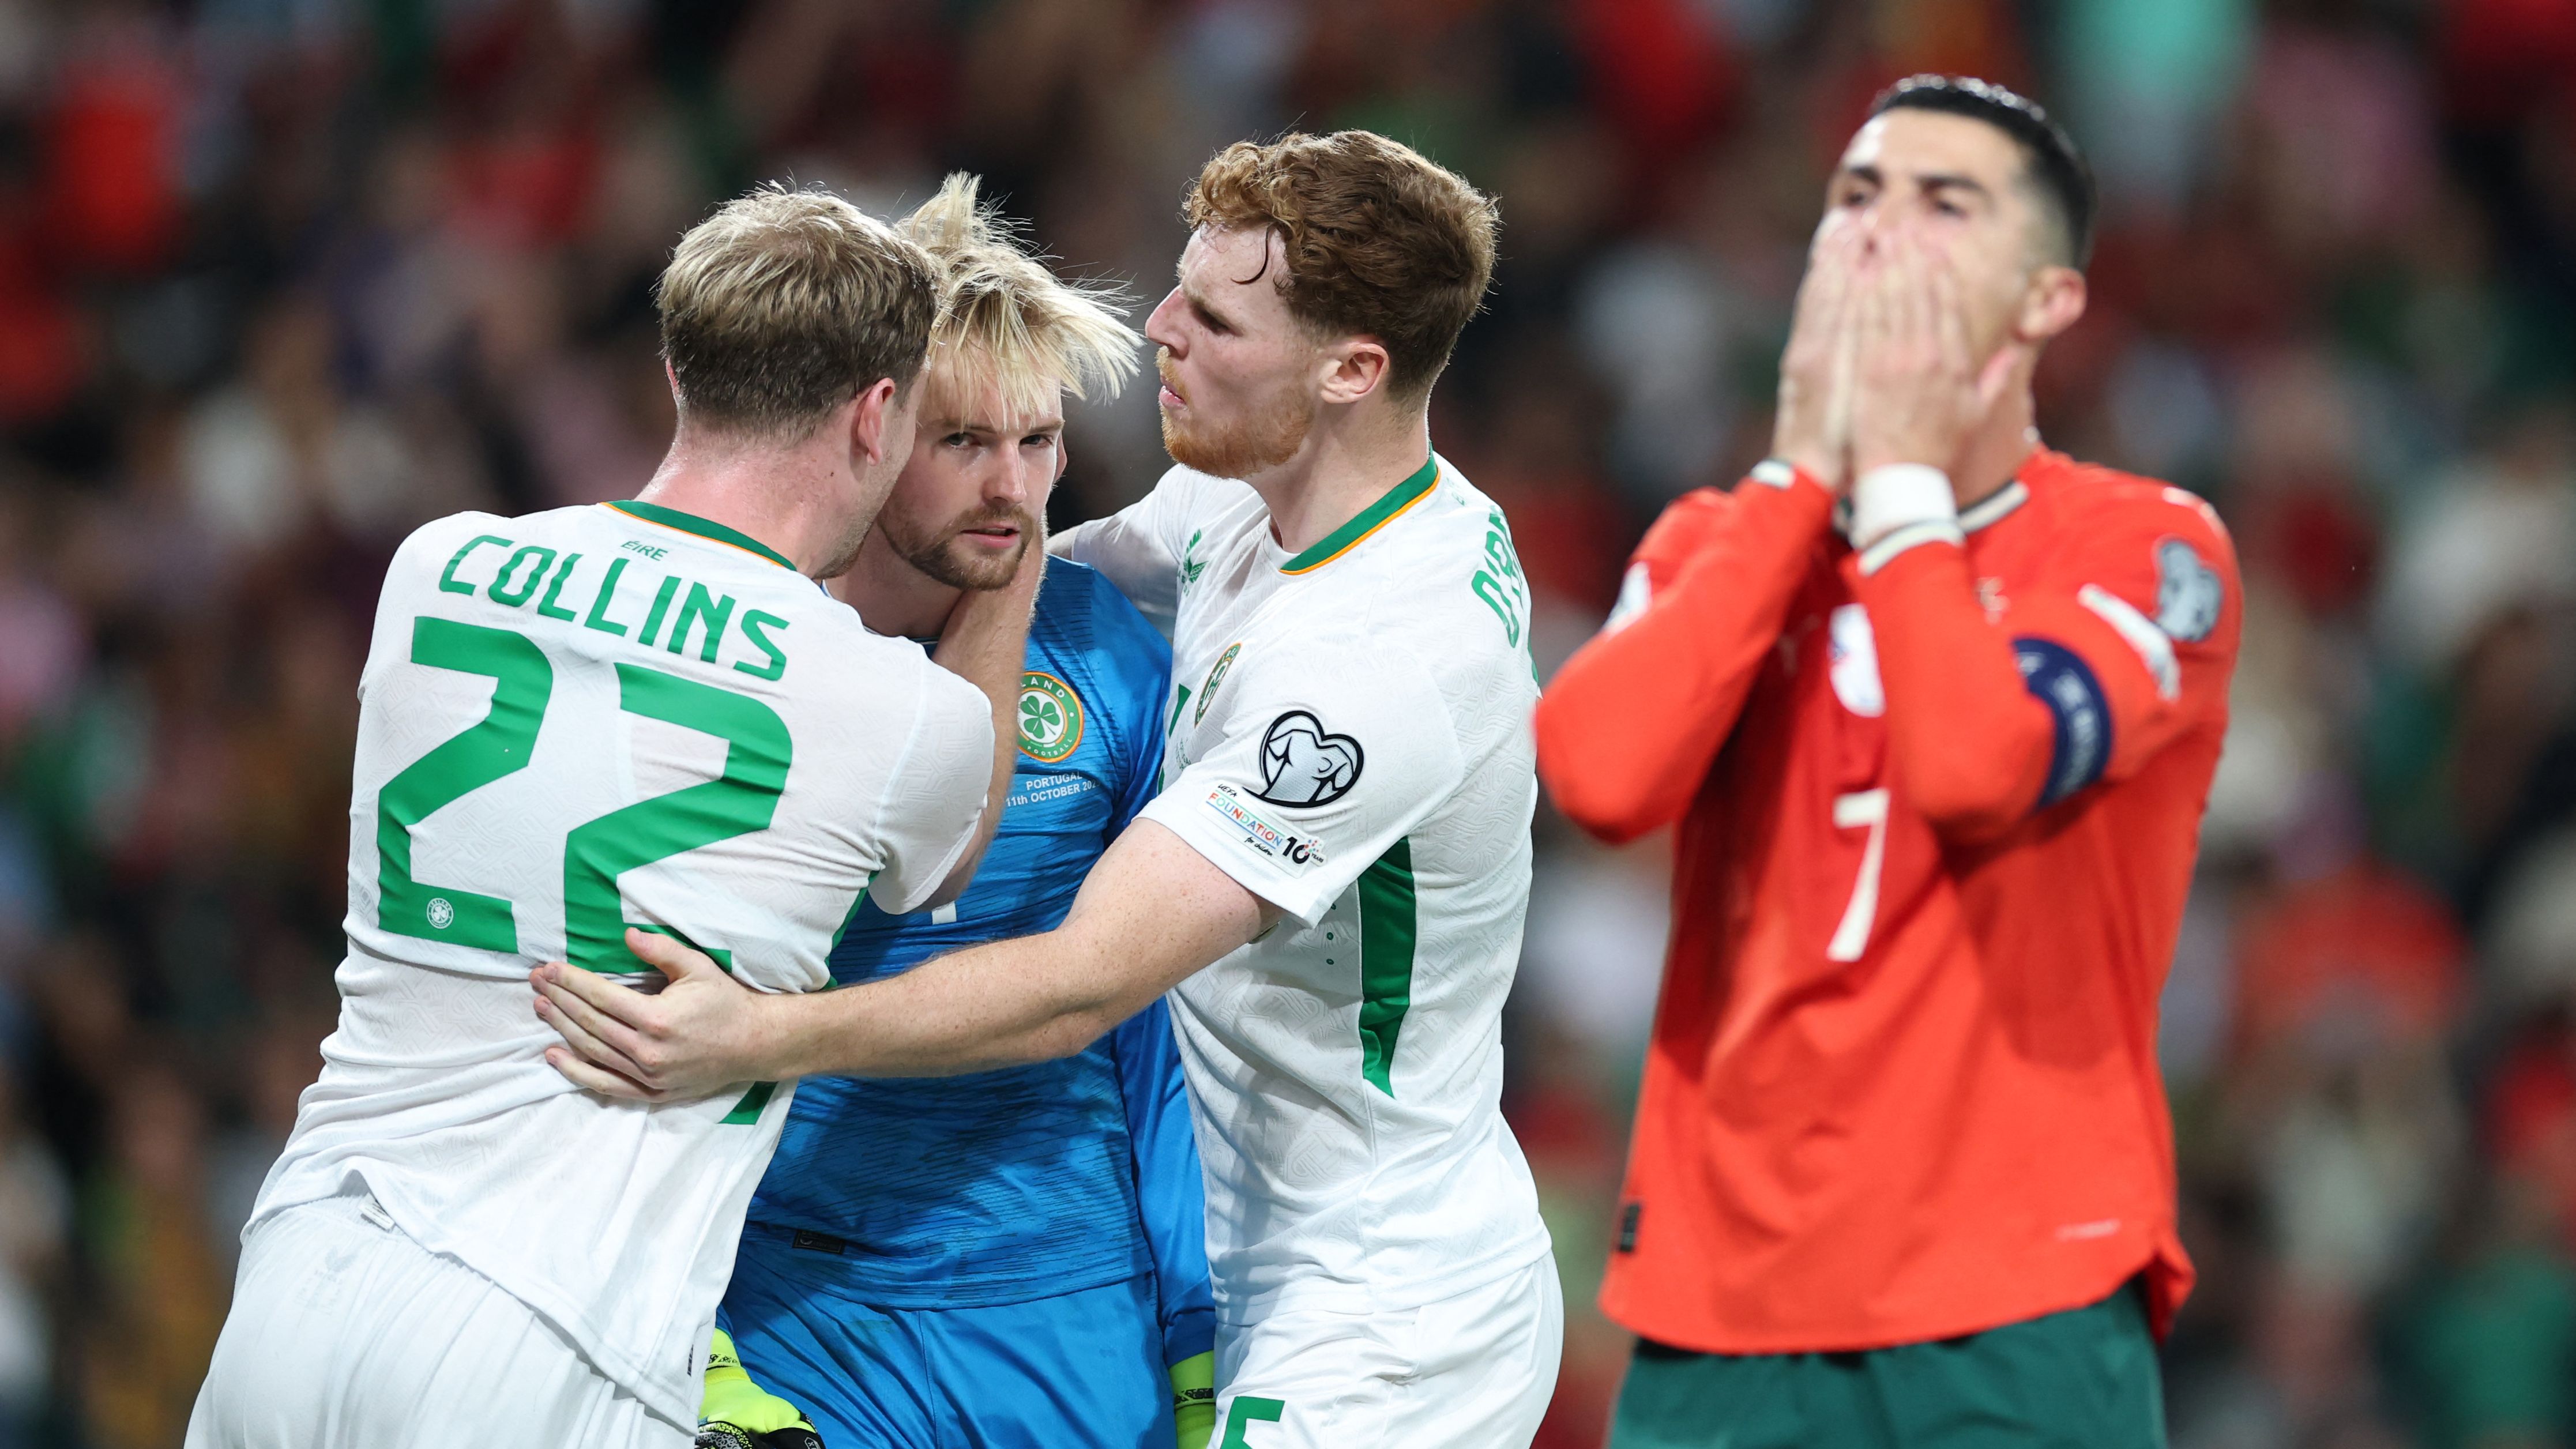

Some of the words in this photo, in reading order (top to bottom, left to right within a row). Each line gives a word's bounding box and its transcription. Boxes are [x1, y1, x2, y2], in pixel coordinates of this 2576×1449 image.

[621, 539, 668, 562] ÉIRE
[439, 535, 789, 680] COLLINS
[1026, 739, 1073, 757] FOOTBALL
[1026, 771, 1083, 791] PORTUGAL
[1218, 784, 1238, 798] UEFA
[377, 616, 793, 973] 22
[1006, 795, 1028, 807] 11th
[1031, 785, 1080, 803] OCTOBER
[1254, 843, 1273, 856] children
[1283, 837, 1310, 864] 10
[1826, 789, 1890, 962] 7
